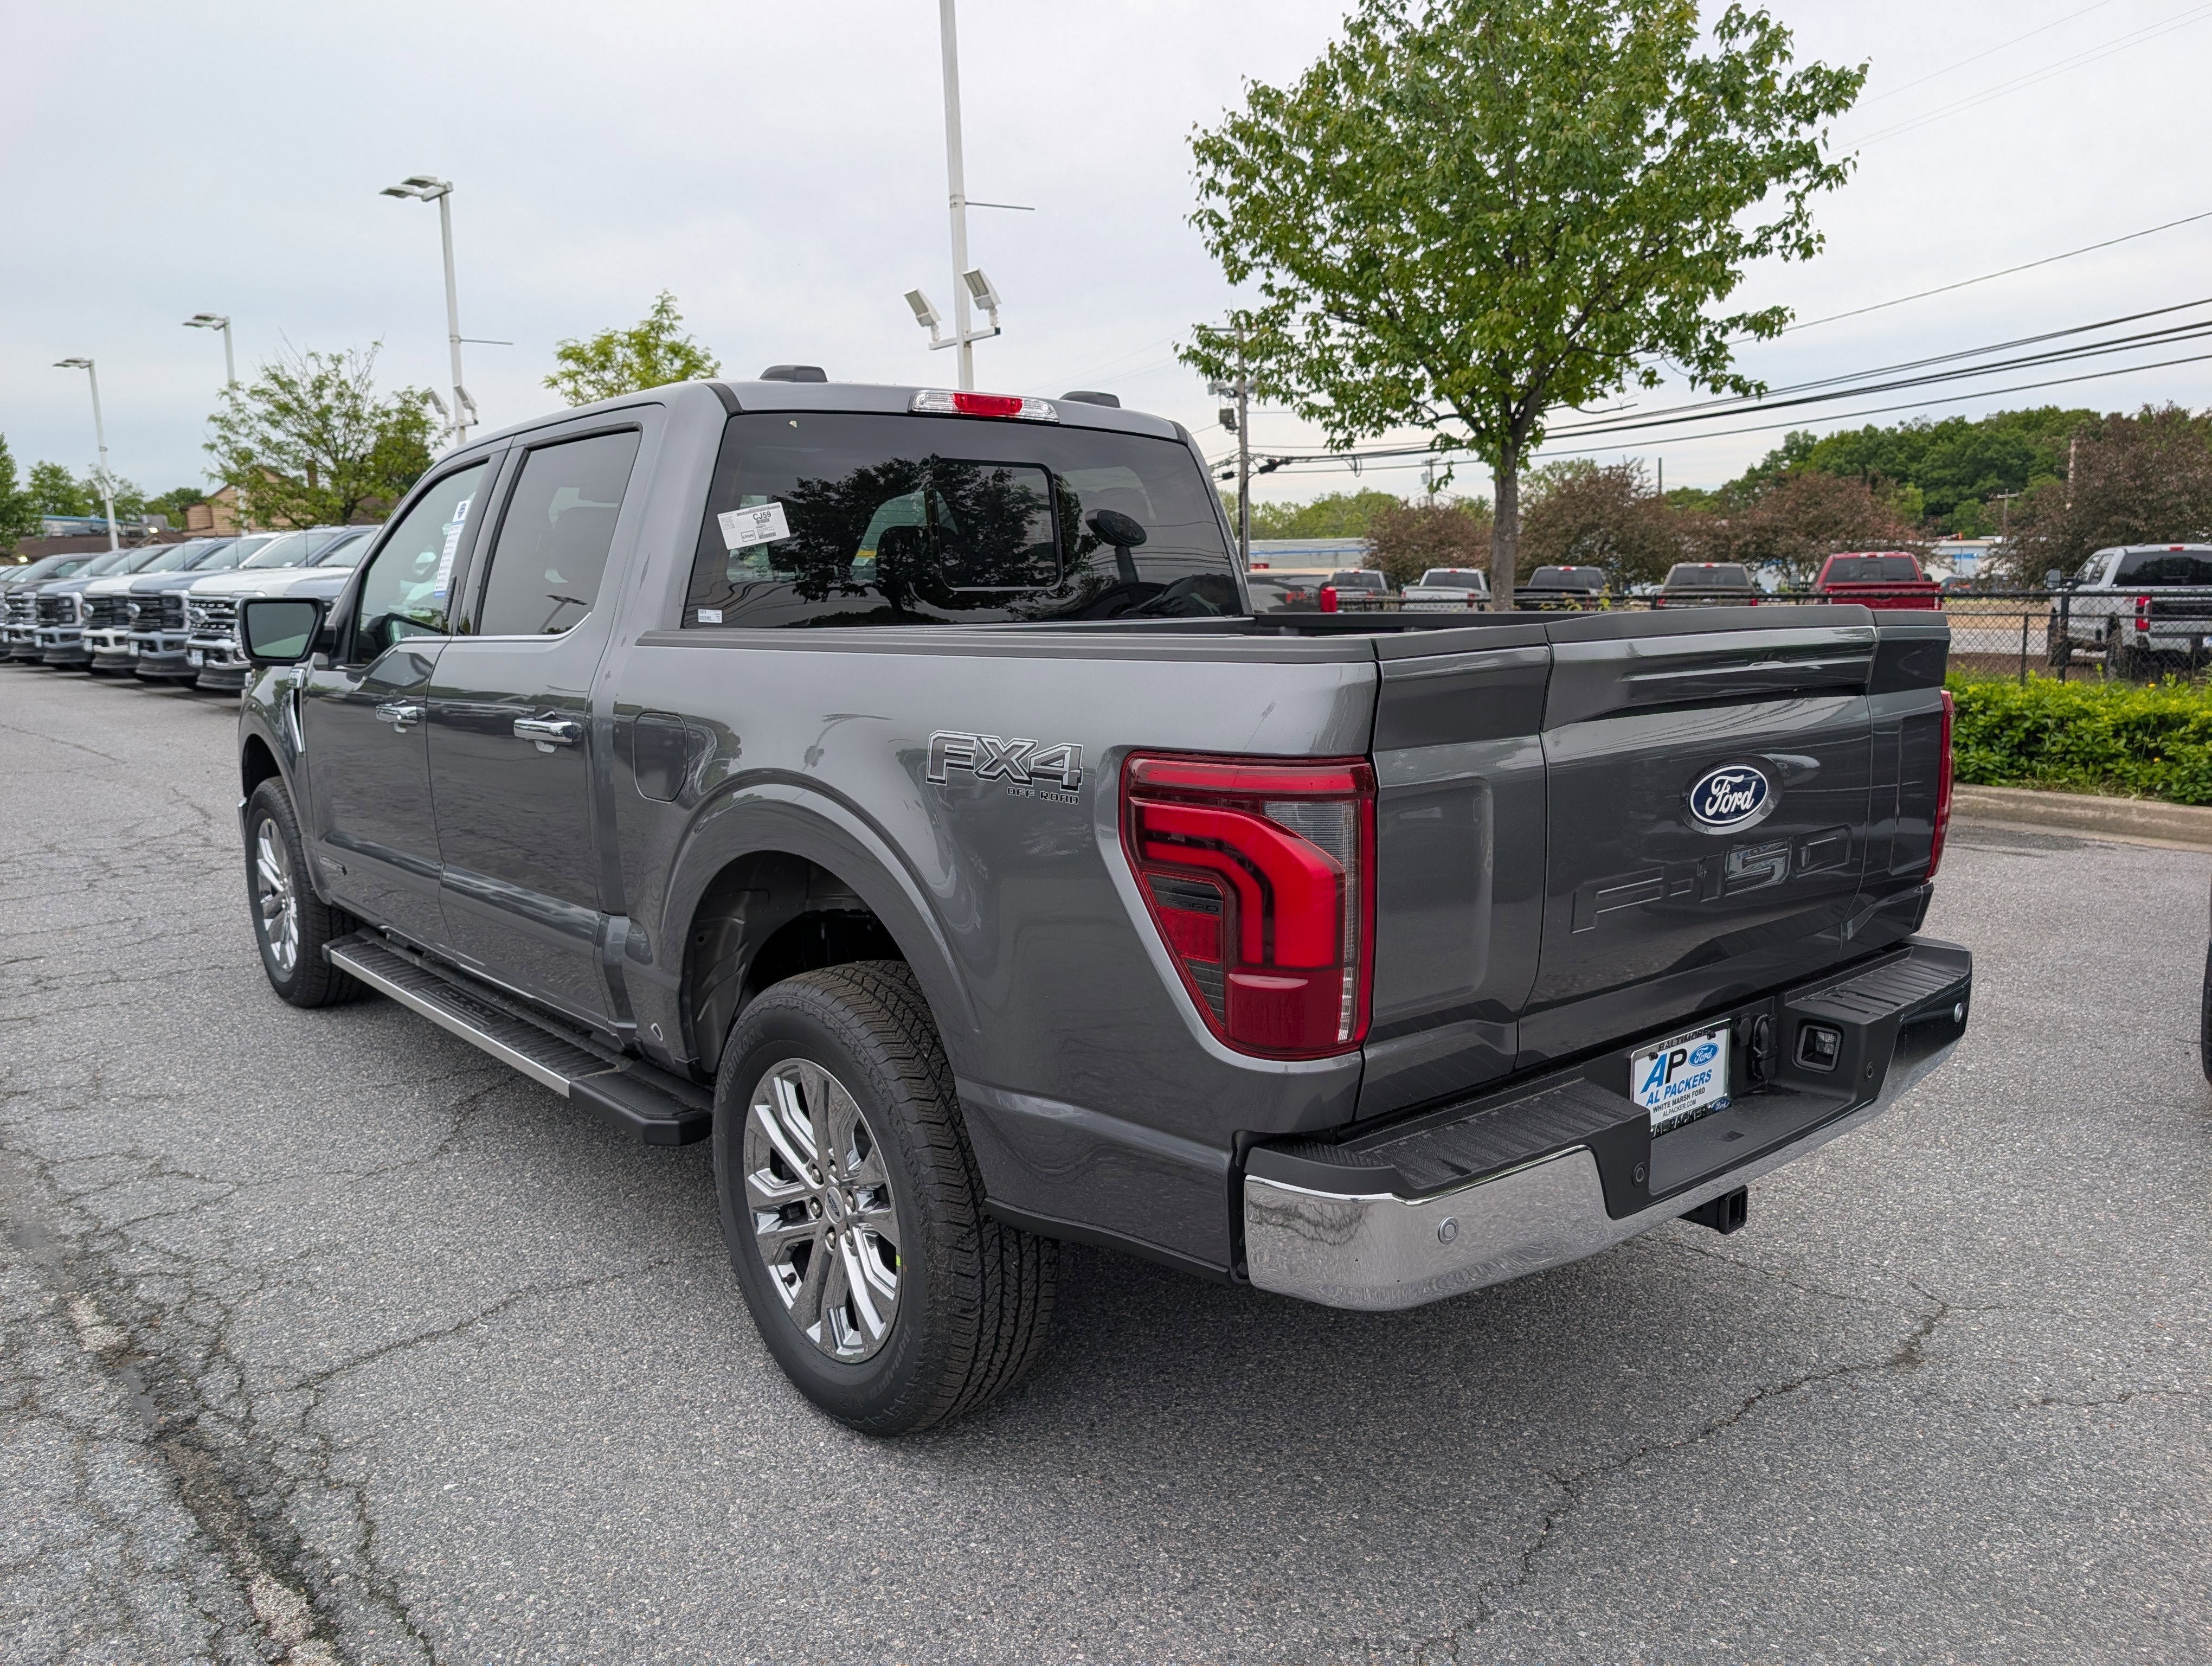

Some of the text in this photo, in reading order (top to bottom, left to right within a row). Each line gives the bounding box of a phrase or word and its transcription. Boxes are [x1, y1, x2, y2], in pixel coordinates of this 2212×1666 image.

[753, 511, 771, 520] CJ59
[926, 729, 1083, 793] FX4
[1007, 786, 1079, 805] OFF ROAD
[1703, 773, 1758, 817] Ford
[1571, 824, 1851, 933] F-150
[1658, 1028, 1708, 1052] BALTIMORE
[1640, 1045, 1715, 1094] AP Ford
[1645, 1069, 1713, 1106] AL PACKERS
[1653, 1087, 1706, 1113] WHITE MARSH FORD
[1662, 1099, 1696, 1117] ALPACKER.COM
[1713, 1099, 1730, 1111] Ford
